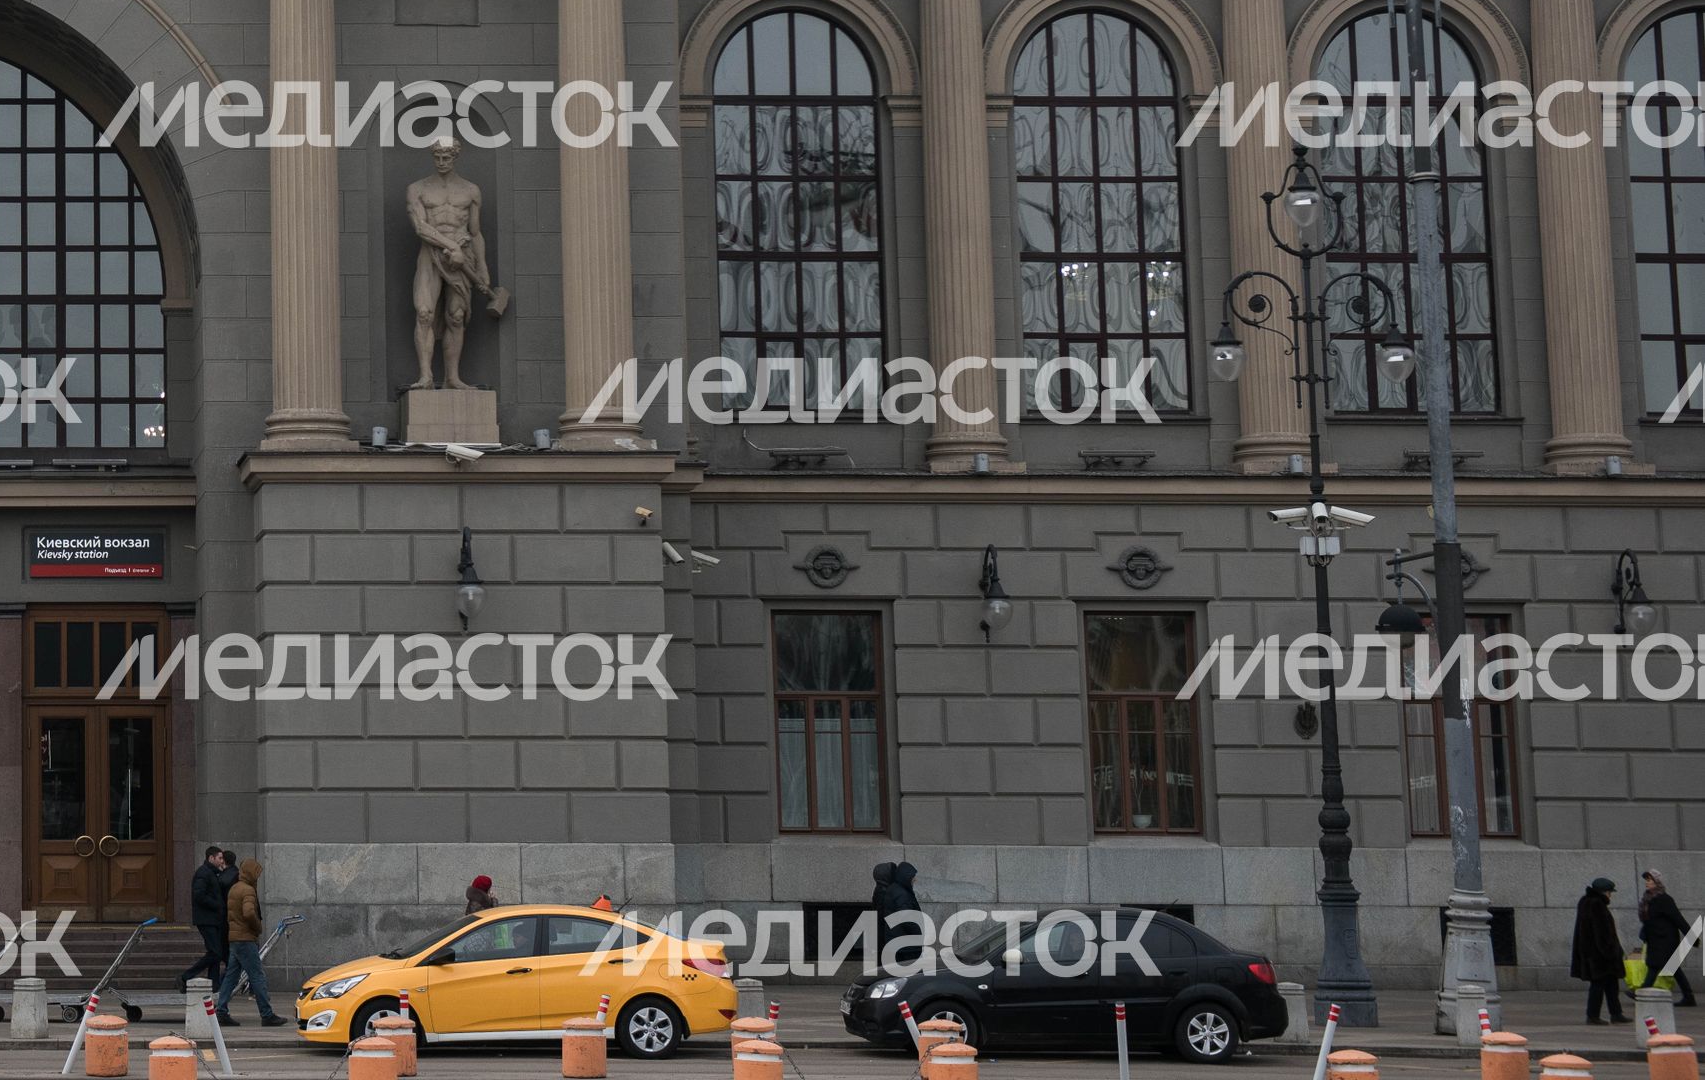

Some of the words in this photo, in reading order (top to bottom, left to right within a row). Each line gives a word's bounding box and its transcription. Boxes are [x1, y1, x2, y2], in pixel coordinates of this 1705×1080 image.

[37, 536, 101, 548] Киевский
[104, 538, 150, 548] вокзал
[37, 549, 73, 561] Kievsky
[74, 550, 109, 559] station
